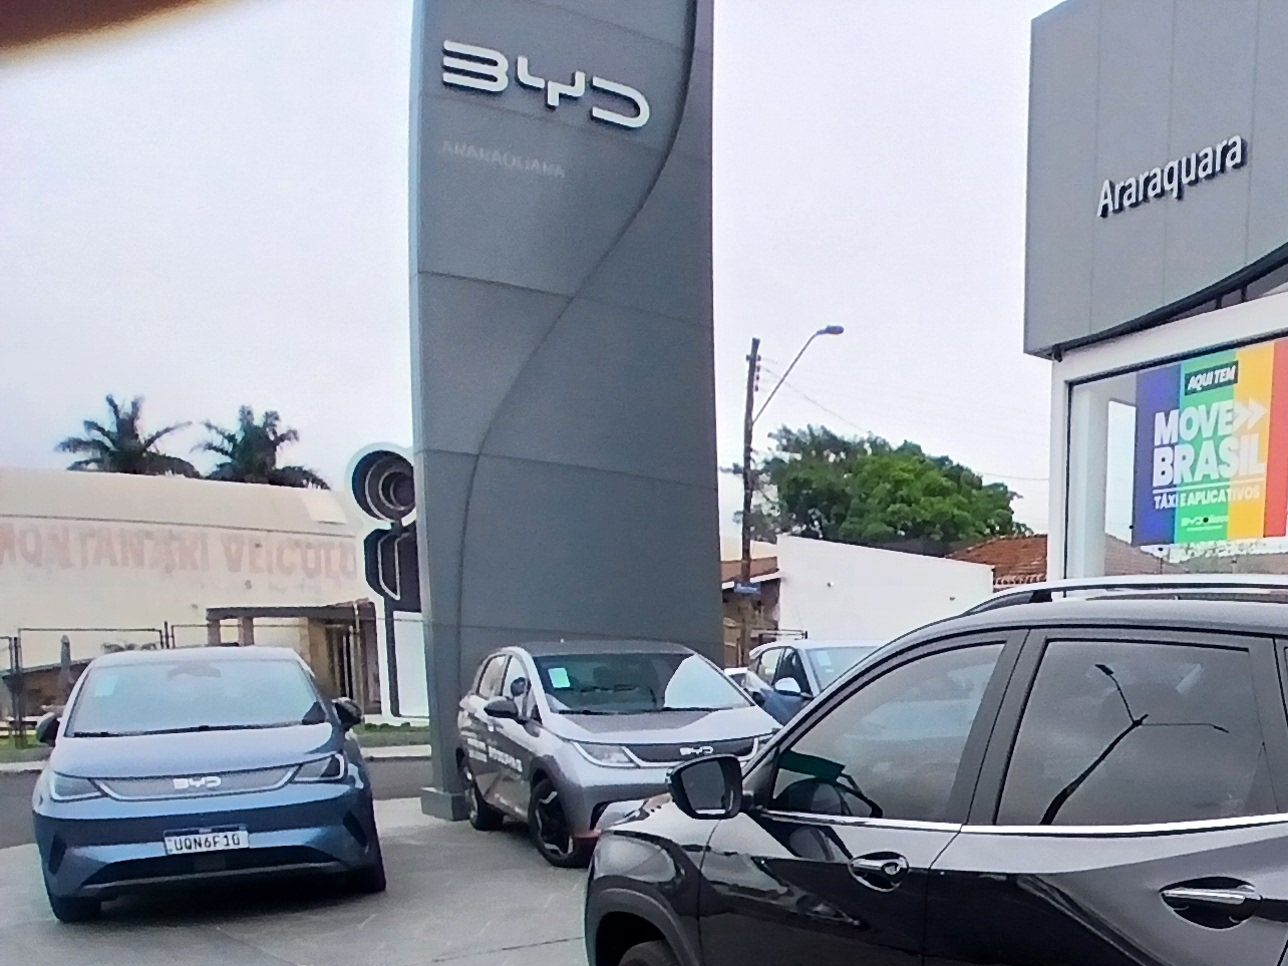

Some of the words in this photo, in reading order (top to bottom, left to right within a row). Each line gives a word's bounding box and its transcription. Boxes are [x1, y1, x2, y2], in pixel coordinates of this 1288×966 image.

[442, 39, 650, 128] BYD
[1097, 134, 1244, 217] Araraquara
[1187, 370, 1213, 390] AQUI
[1214, 365, 1236, 383] TEM
[1153, 400, 1234, 445] MOVE
[1152, 433, 1265, 488] BRASIL
[1180, 493, 1187, 507] E
[1187, 485, 1260, 507] APLICATIVOS
[173, 775, 222, 789] BYD
